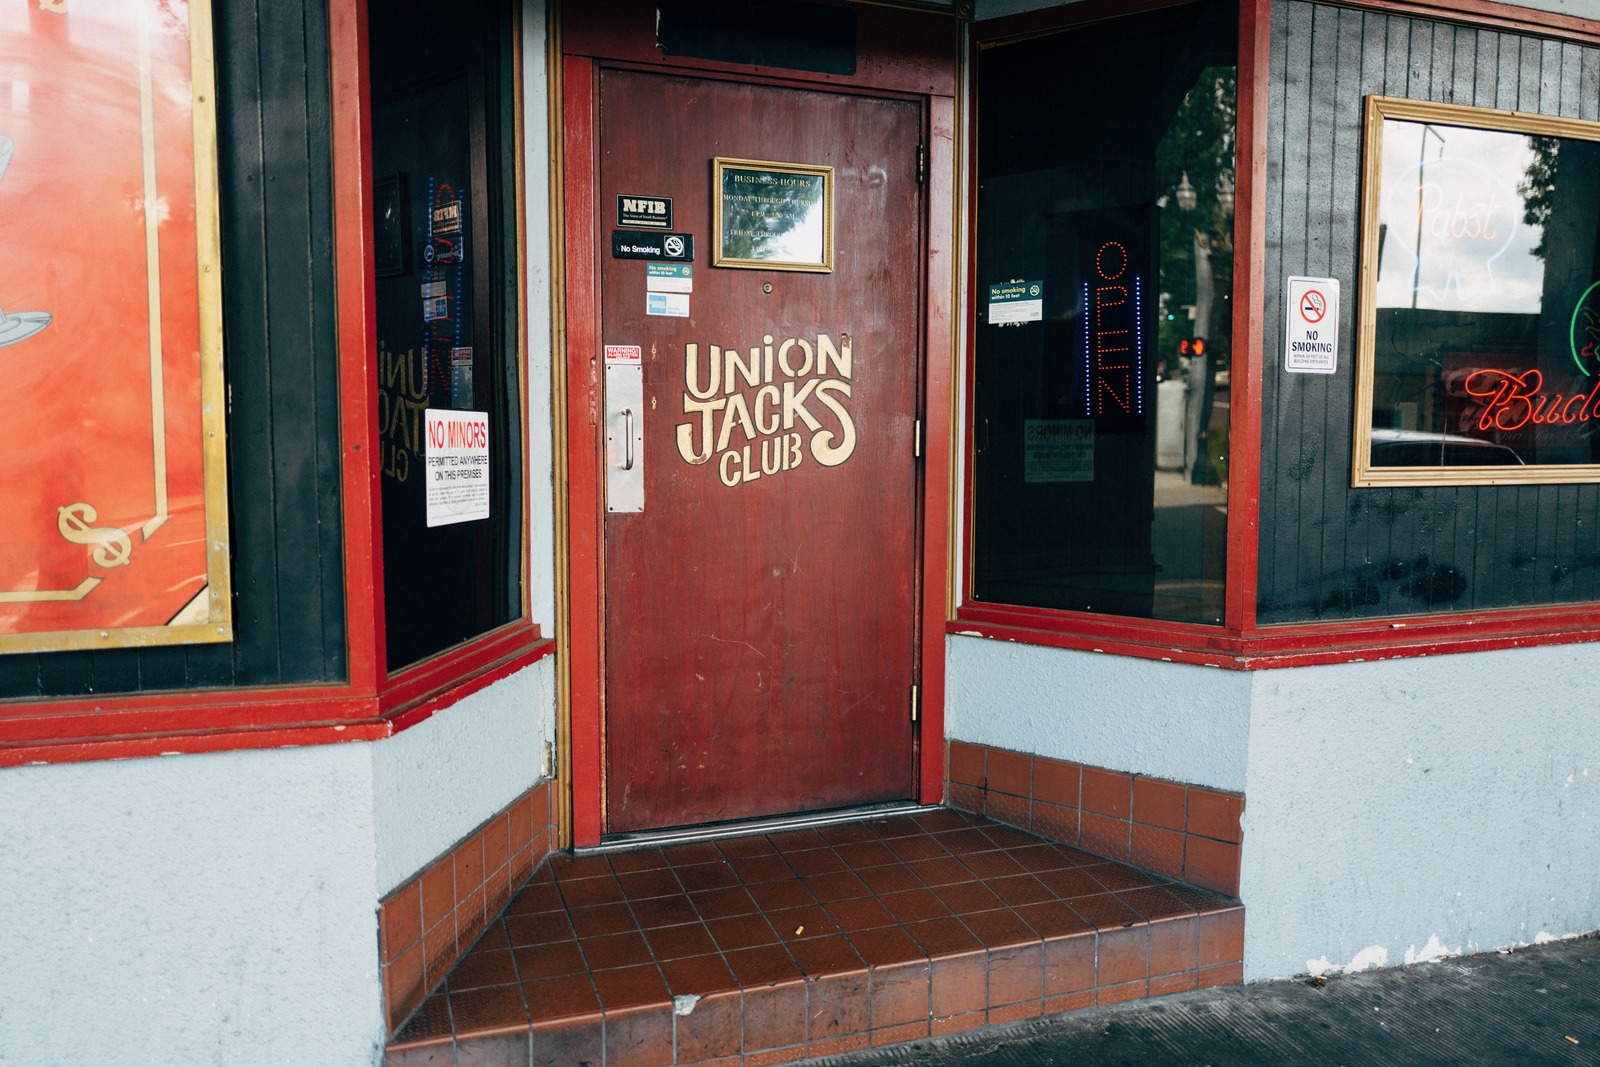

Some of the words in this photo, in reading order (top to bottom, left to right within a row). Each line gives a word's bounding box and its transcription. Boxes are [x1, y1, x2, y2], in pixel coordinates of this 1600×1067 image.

[734, 174, 778, 185] BUSINESS
[780, 178, 811, 188] HOURS
[623, 198, 666, 215] NFIB
[1413, 182, 1501, 241] Pabst
[620, 244, 631, 253] No
[632, 244, 661, 256] Smoking
[1001, 286, 1026, 295] smoking
[1097, 241, 1130, 415] OPEN
[1306, 330, 1319, 341] NO
[1291, 341, 1332, 353] SMOKING
[675, 378, 858, 467] JACKS
[428, 420, 445, 449] NO
[448, 421, 487, 449] MINORS
[428, 455, 459, 467] PERMITTED
[459, 454, 488, 466] ANYWHERE
[718, 432, 804, 487] CLUB
[435, 471, 444, 481] ON
[444, 470, 456, 481] THIS
[456, 468, 482, 480] PREMISES
